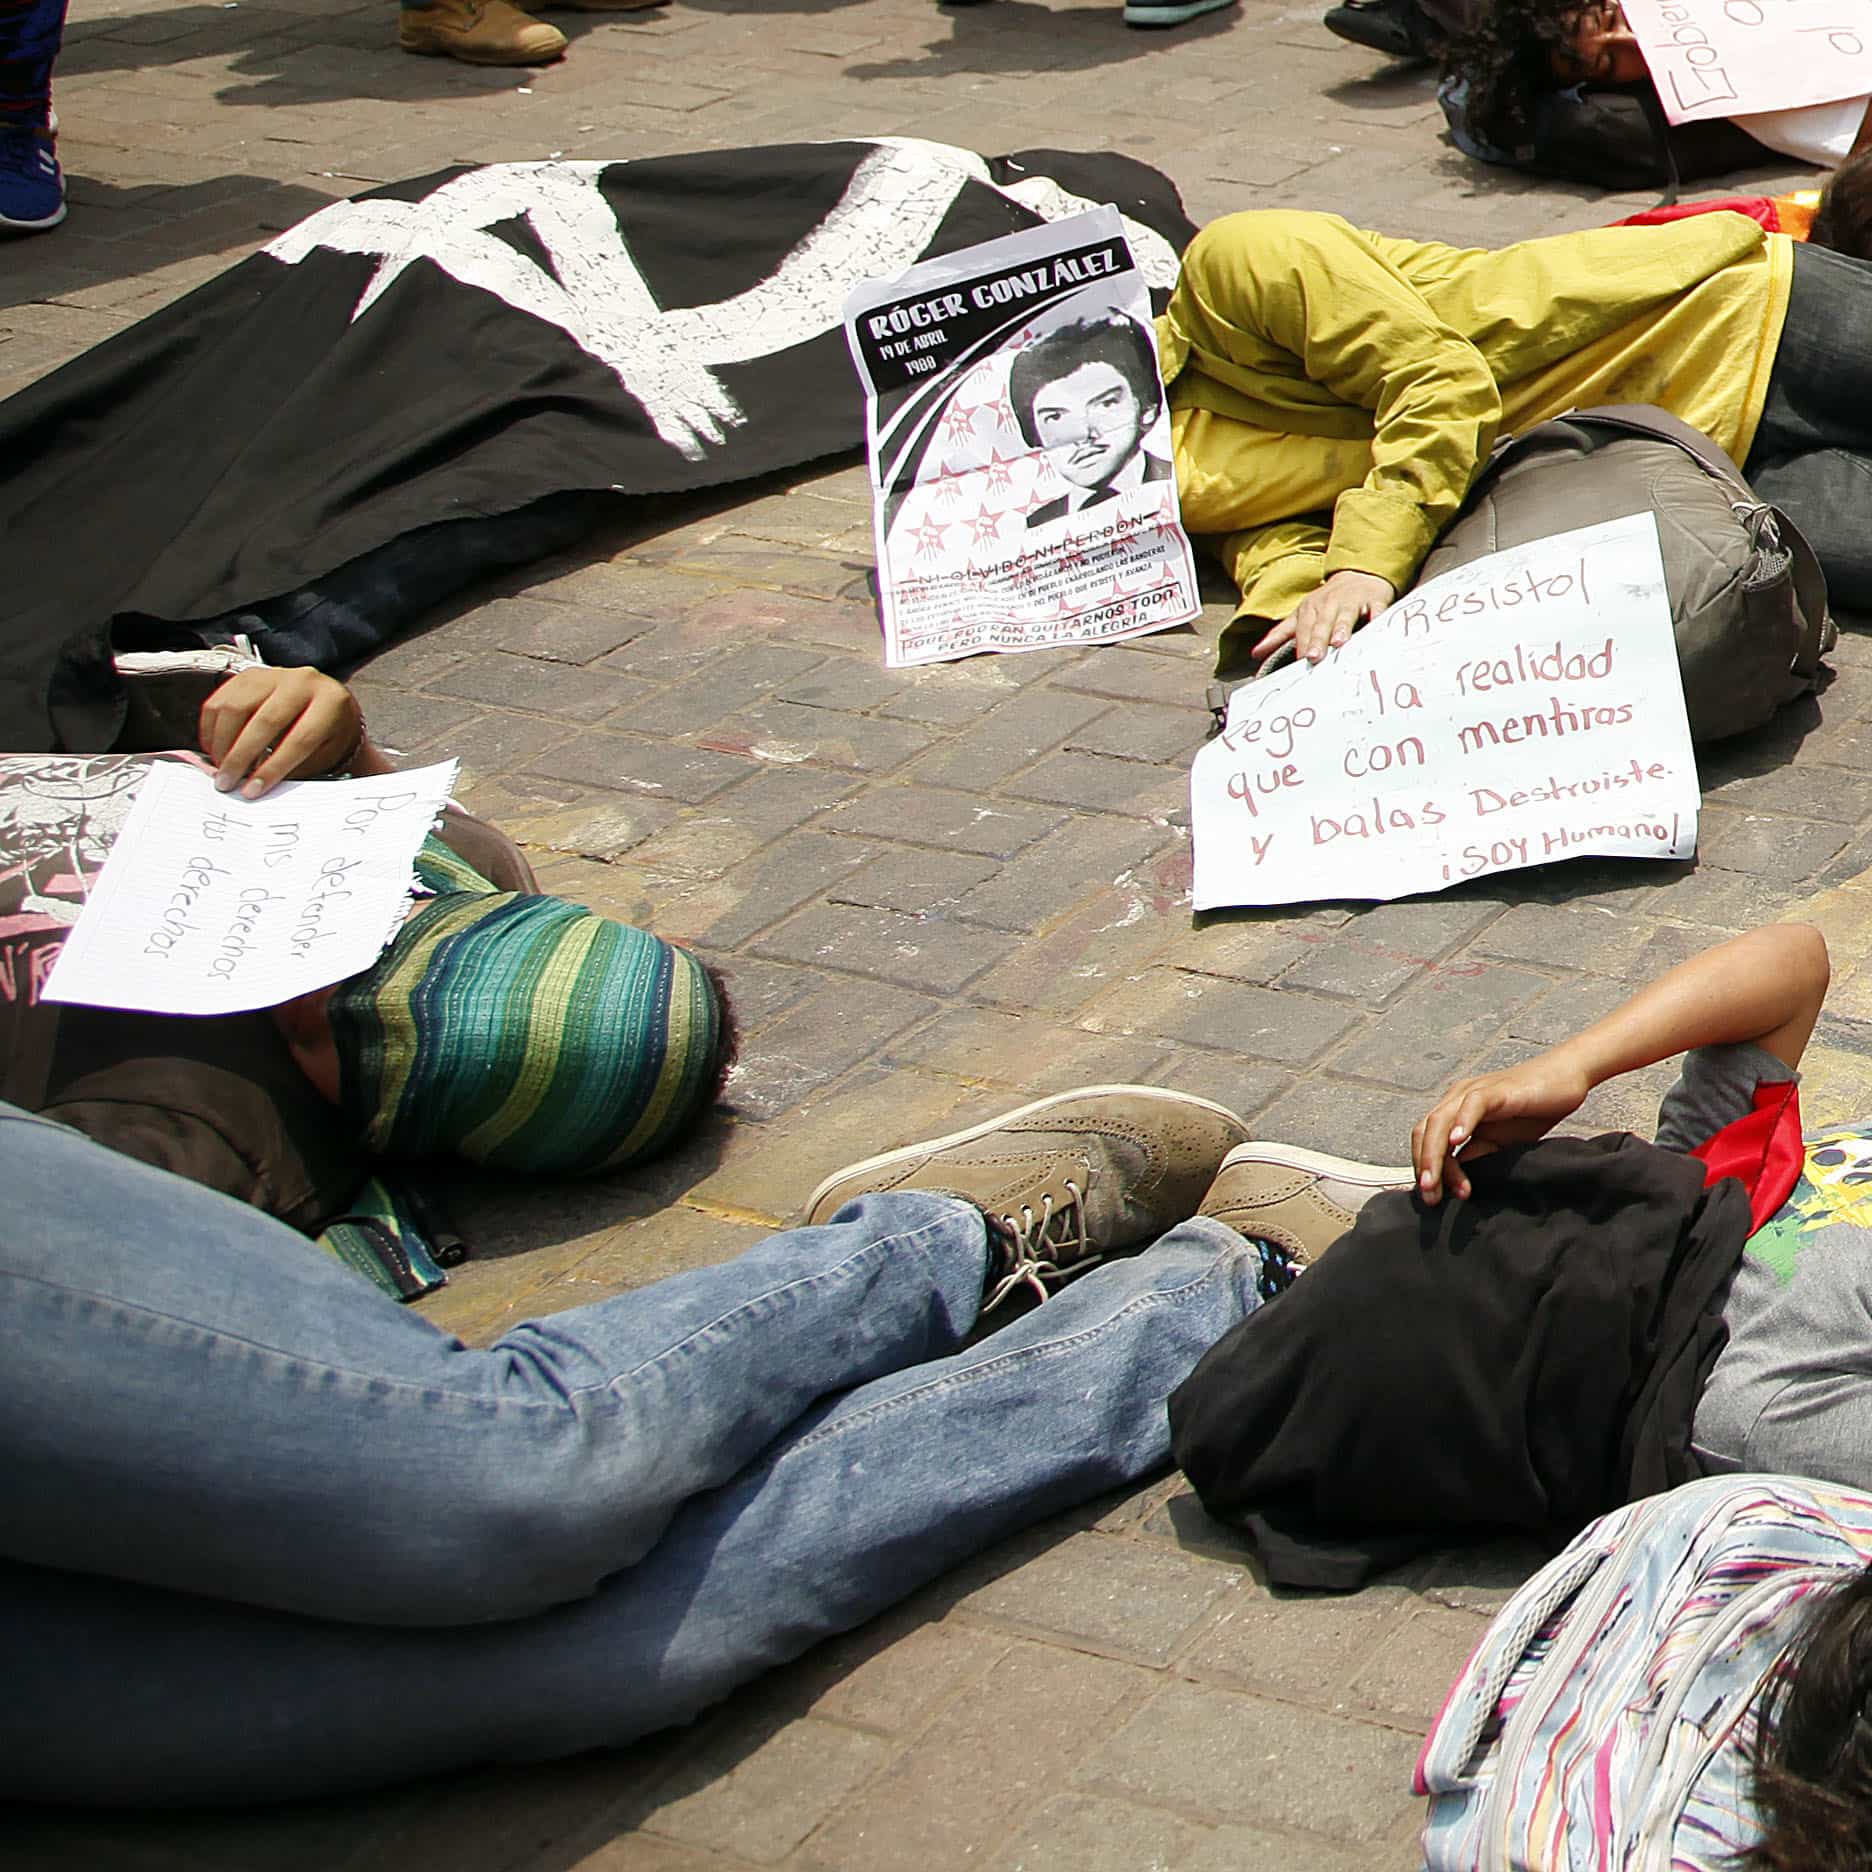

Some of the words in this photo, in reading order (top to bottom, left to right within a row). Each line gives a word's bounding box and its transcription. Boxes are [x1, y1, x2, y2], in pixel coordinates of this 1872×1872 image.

[972, 248, 1121, 310] GONZÁLEZ
[879, 344, 895, 361] 19
[895, 338, 914, 358] DE
[914, 329, 948, 351] ABRIL
[1369, 669, 1423, 715] la
[1455, 638, 1618, 696] realidad
[1226, 760, 1304, 818] que
[1343, 736, 1427, 779] con
[1457, 696, 1634, 756] mentiras
[1310, 797, 1448, 847] balas
